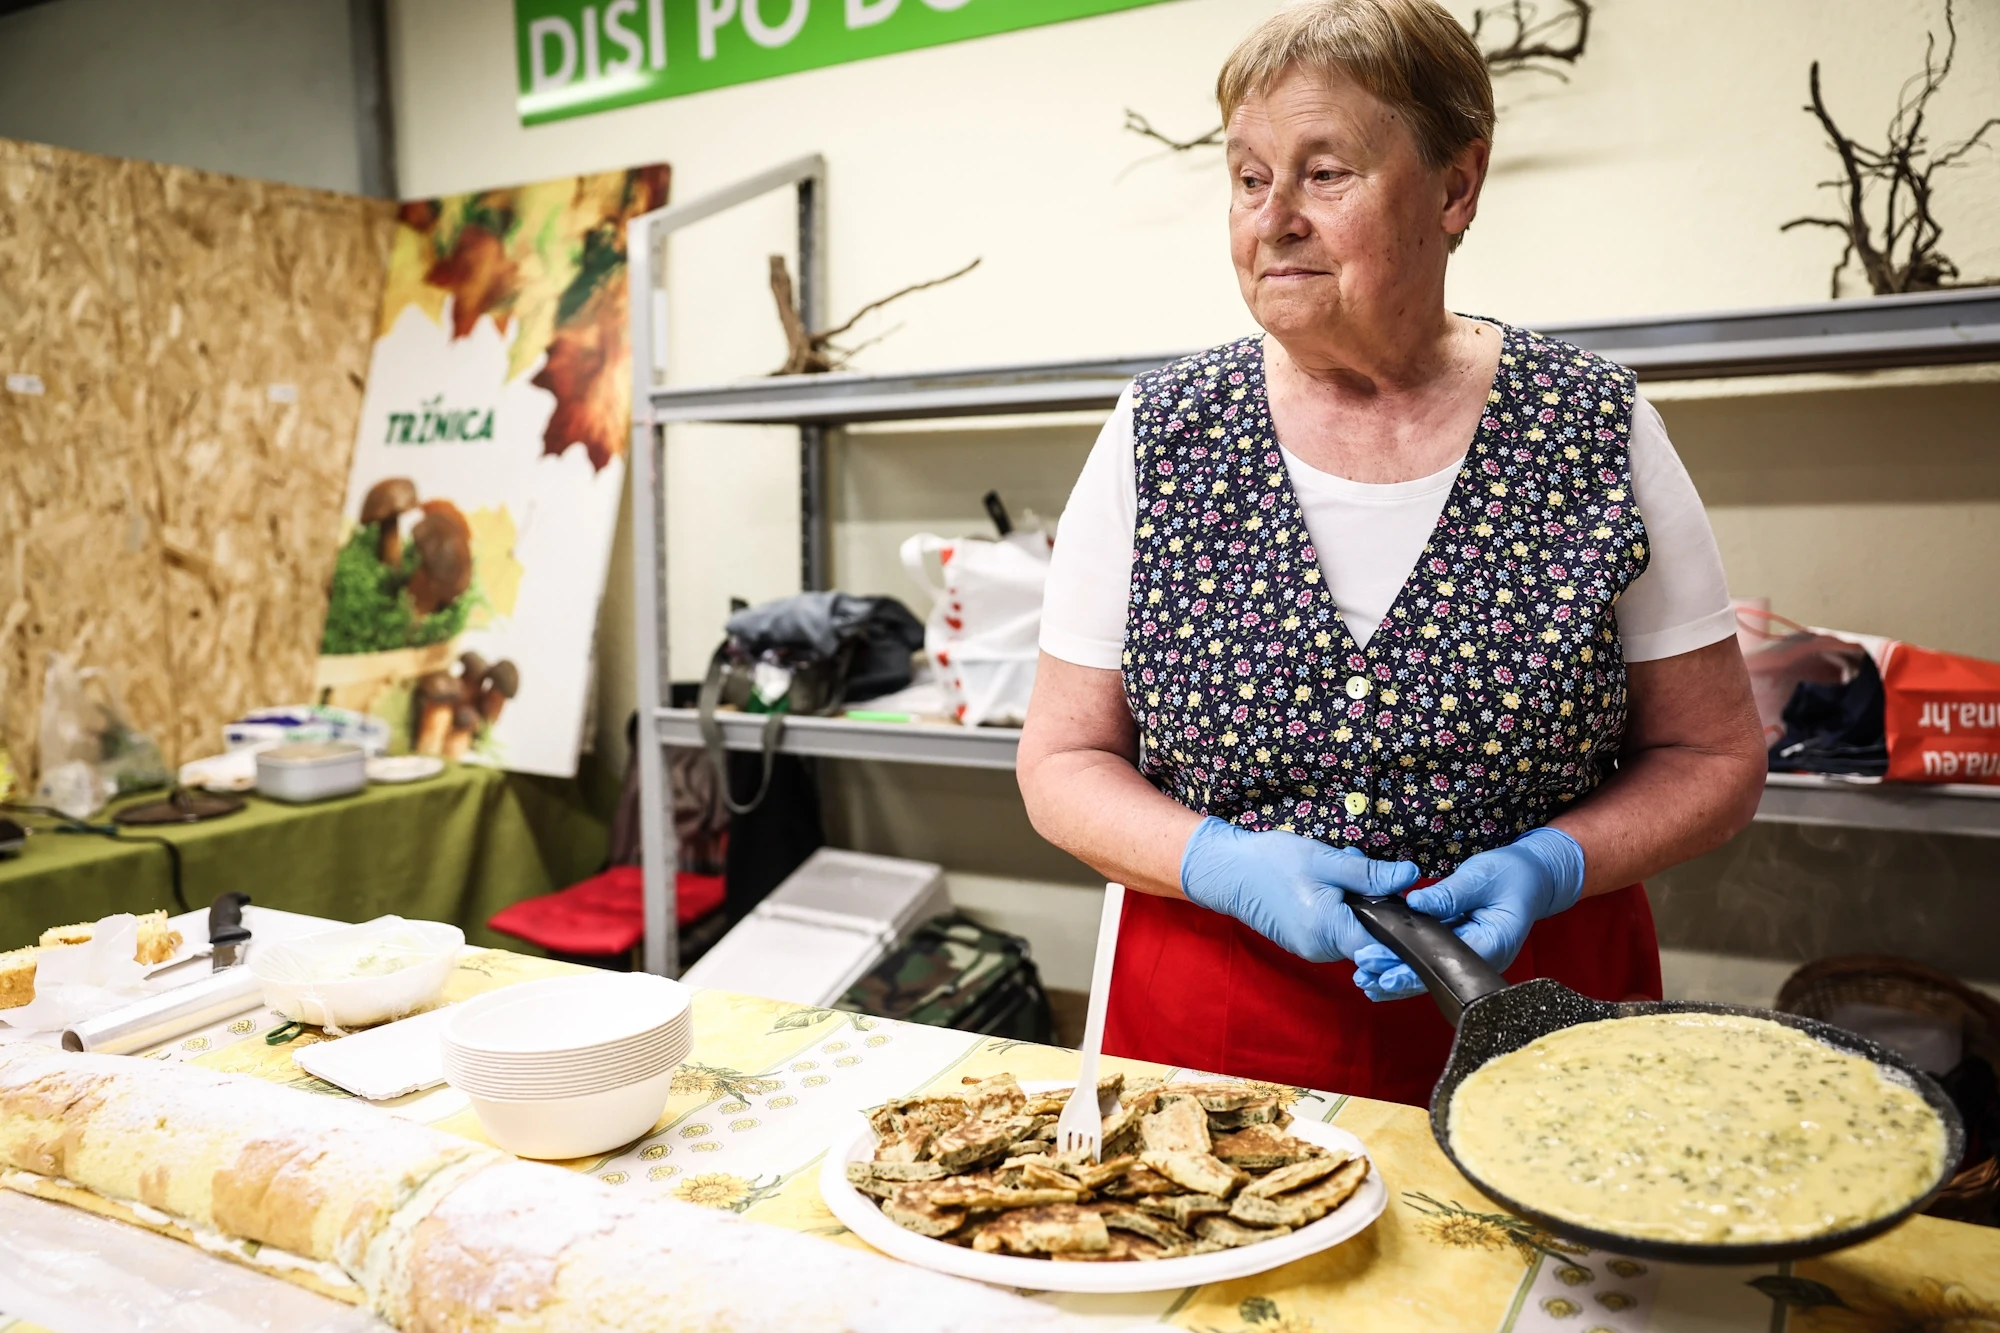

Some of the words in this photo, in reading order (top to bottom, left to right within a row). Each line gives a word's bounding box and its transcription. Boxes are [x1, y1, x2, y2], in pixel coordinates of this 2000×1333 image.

[696, 0, 809, 60] PO
[384, 393, 494, 444] TRŽNICA
[1918, 702, 2000, 734] na.hr
[1922, 750, 2000, 776] na.eu
